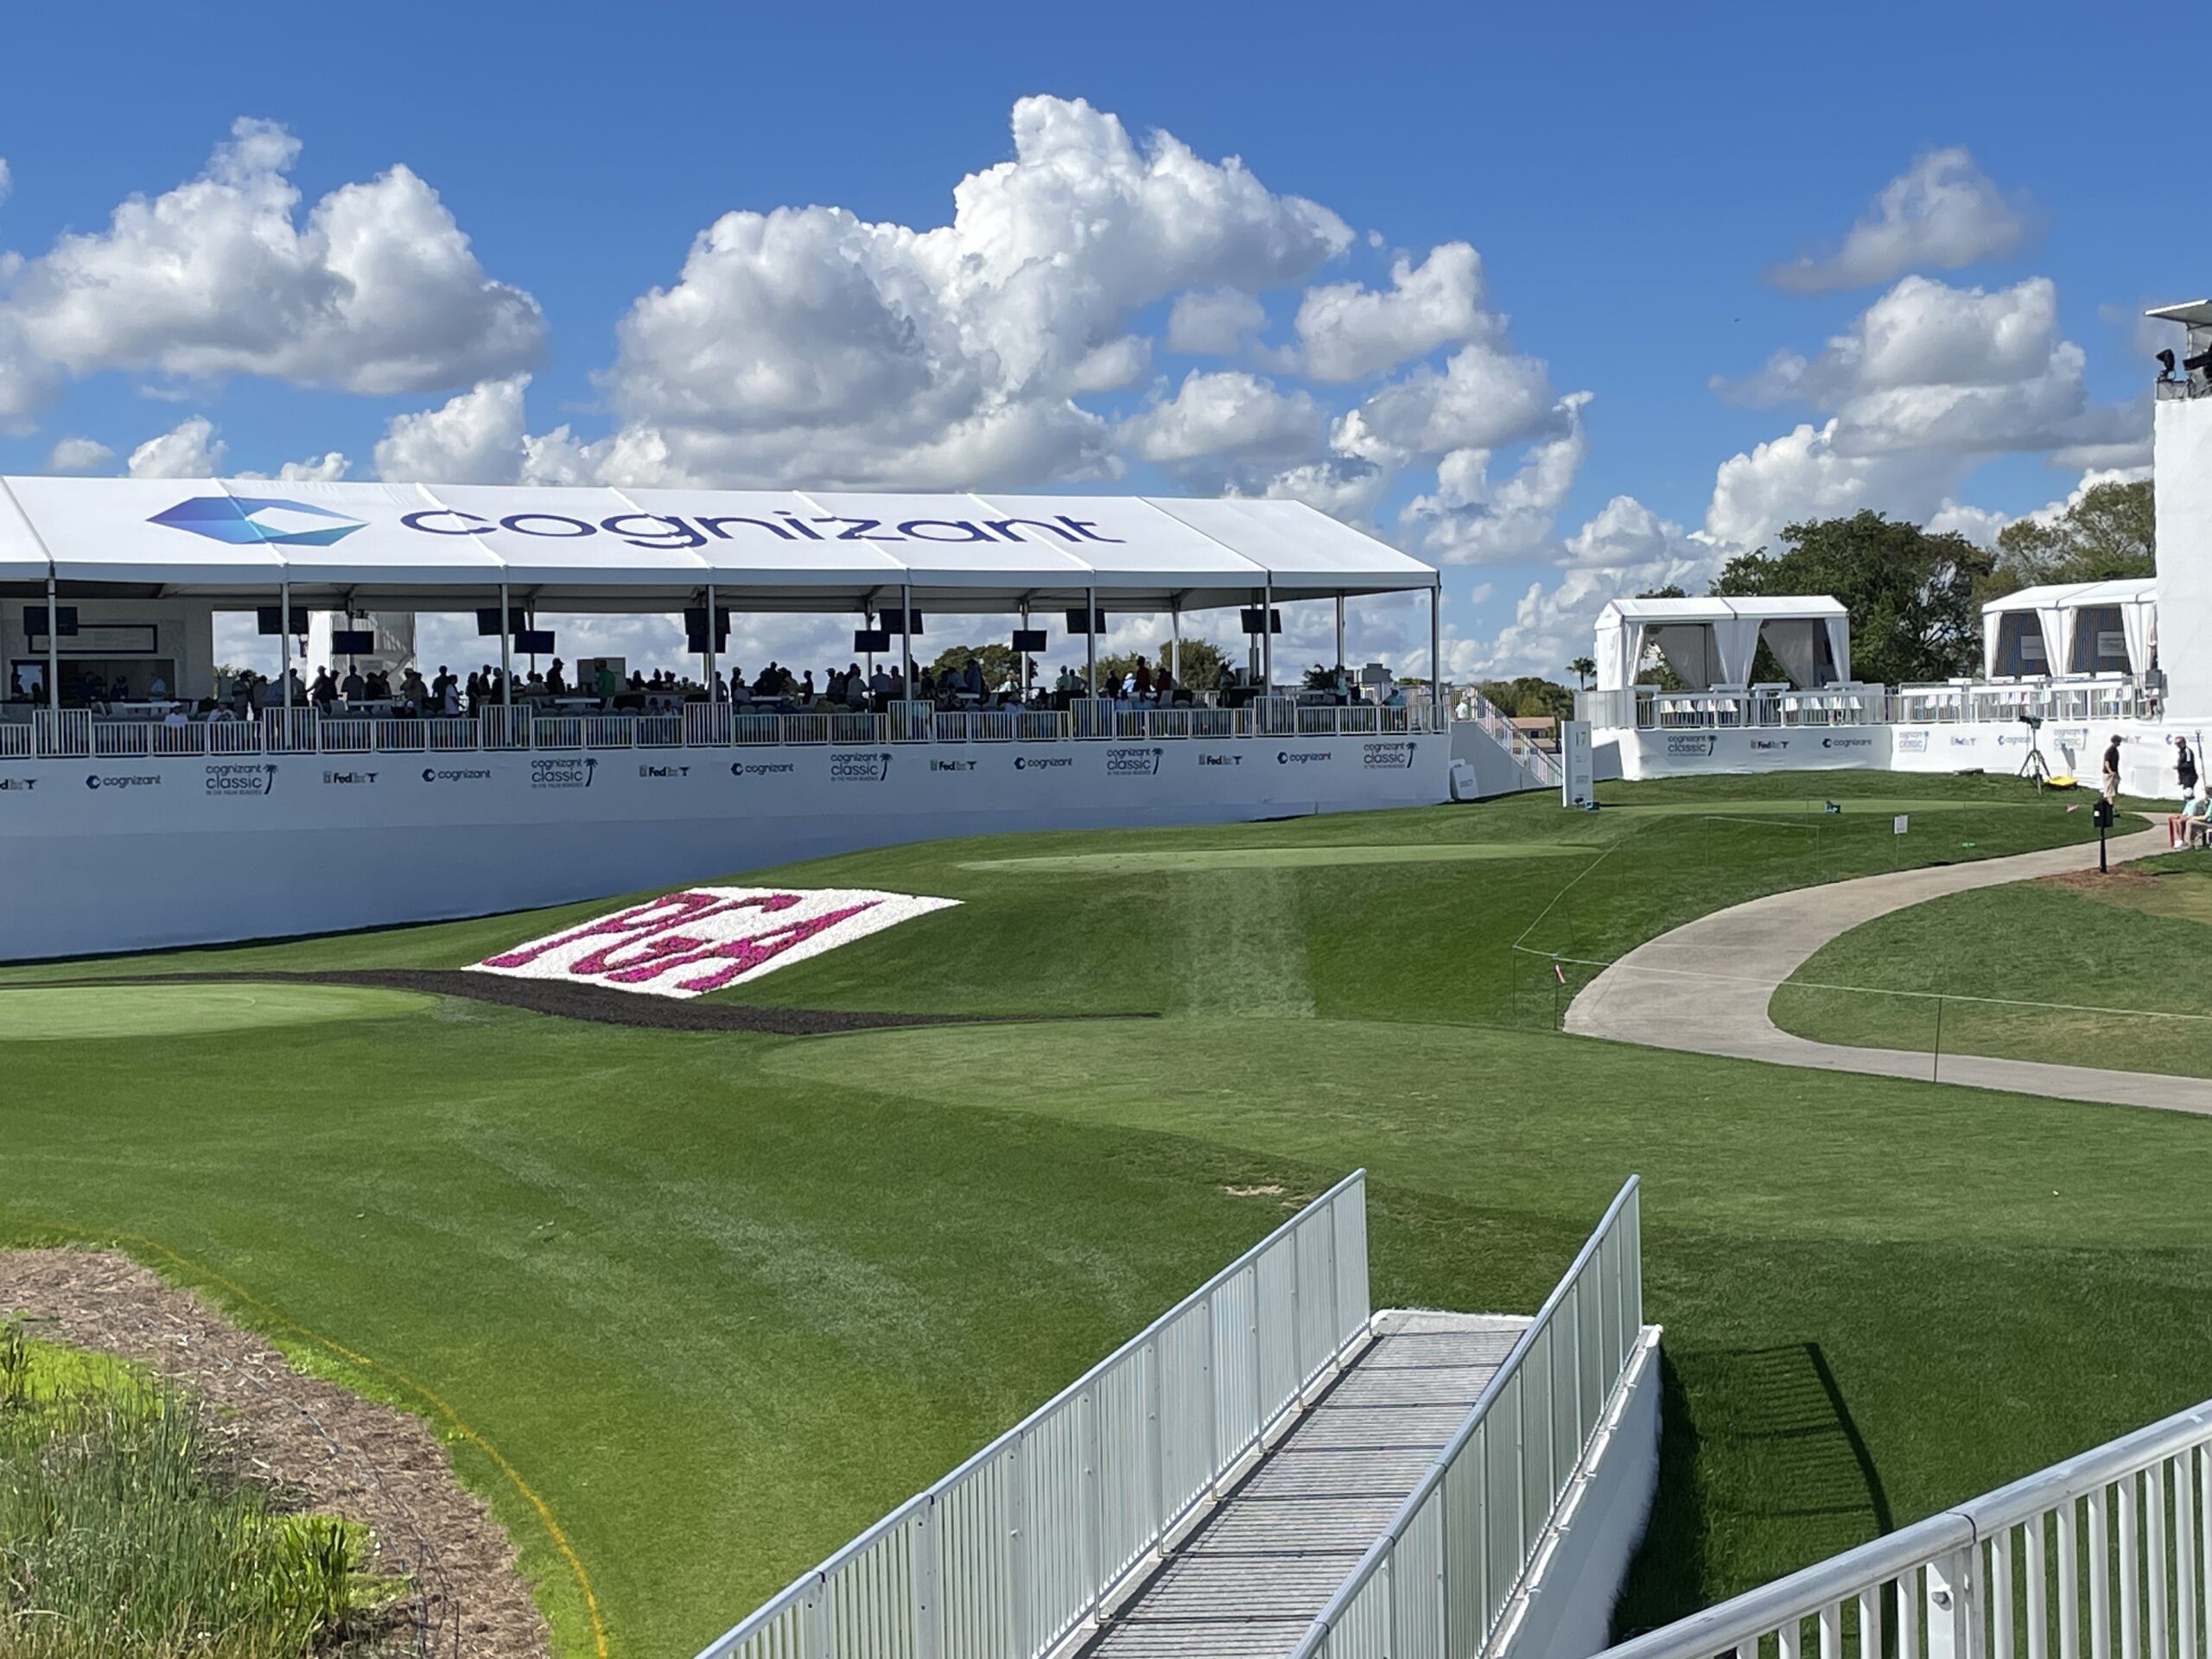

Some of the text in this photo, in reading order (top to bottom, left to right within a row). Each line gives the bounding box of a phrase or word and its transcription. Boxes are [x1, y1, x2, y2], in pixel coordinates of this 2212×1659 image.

[400, 510, 1126, 549] cognizant
[1576, 731, 1586, 747] 17
[1107, 747, 1150, 759] cognizant
[1363, 742, 1404, 753] cognizant
[1668, 743, 1706, 754] classic
[531, 758, 582, 770] cognizant
[830, 753, 878, 763] cognizant
[1027, 758, 1072, 769] cognizant
[1107, 757, 1151, 771] classic
[1289, 753, 1332, 764] cognizant
[1363, 751, 1405, 765] classic
[206, 764, 262, 775] cognizant
[745, 763, 793, 775] cognizant
[831, 762, 878, 775] classic
[206, 773, 262, 789] classic
[438, 769, 491, 782] cognizant
[531, 768, 583, 783] classic
[103, 775, 161, 789] cognizant
